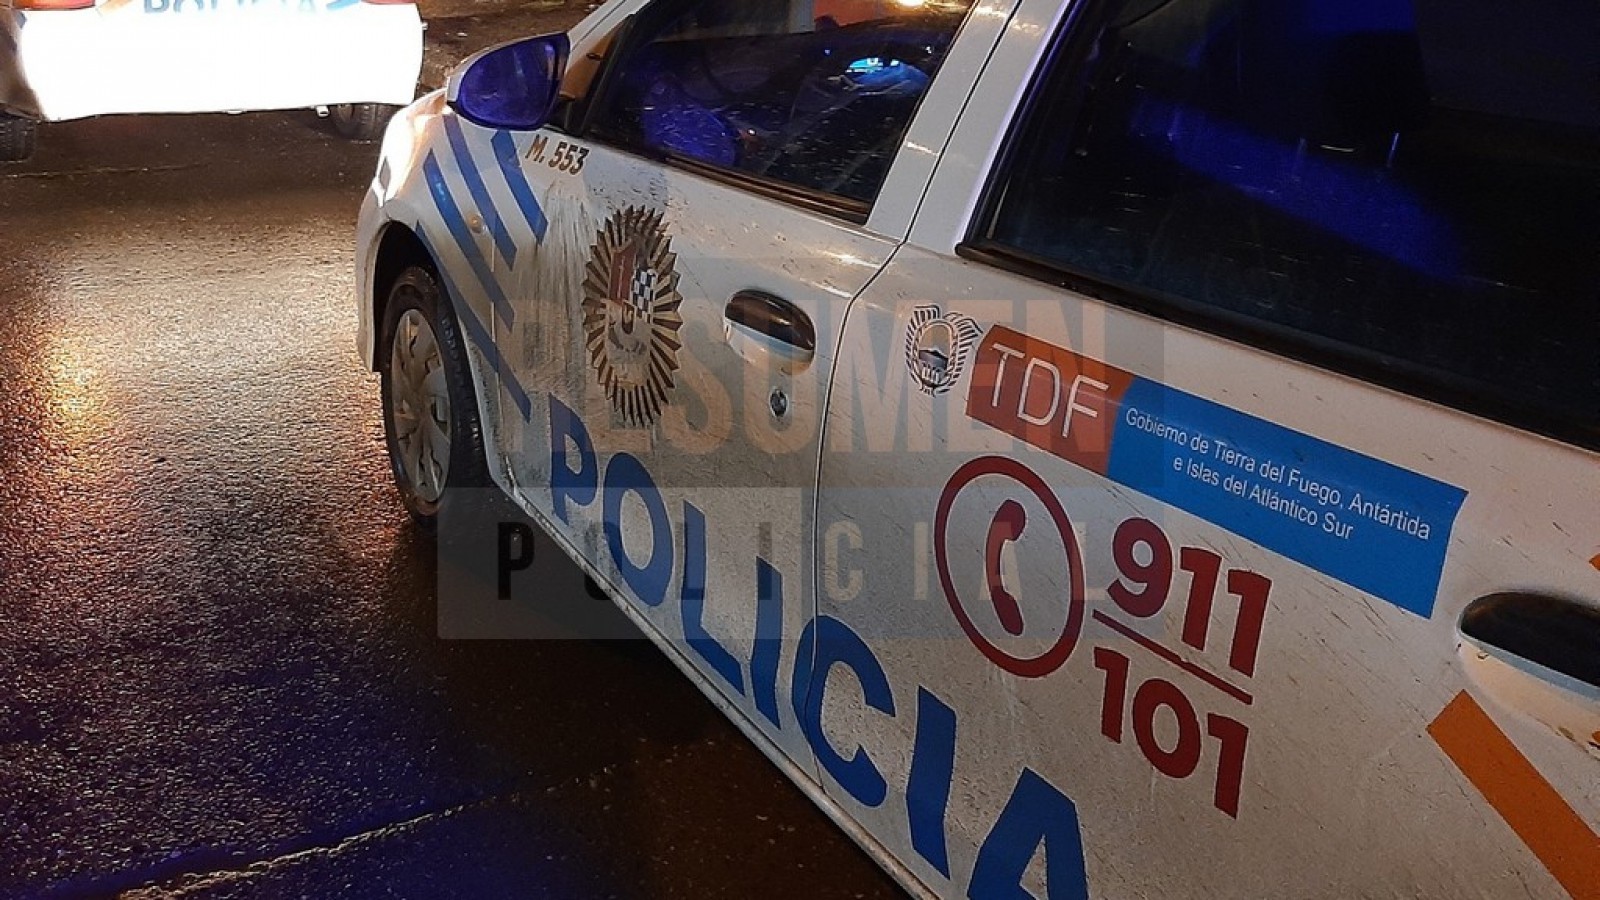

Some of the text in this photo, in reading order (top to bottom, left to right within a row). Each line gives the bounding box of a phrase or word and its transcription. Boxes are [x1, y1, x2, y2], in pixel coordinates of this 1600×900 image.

[525, 134, 590, 175] M. 553
[990, 342, 1110, 438] TDF
[1126, 407, 1431, 540] Gobierno de Tierra del Fuego, Antártida
[1173, 457, 1354, 539] e Islas del Atlántico Sur
[549, 395, 1089, 900] POLICIA
[1107, 517, 1272, 678] 911
[1094, 646, 1249, 820] 101
